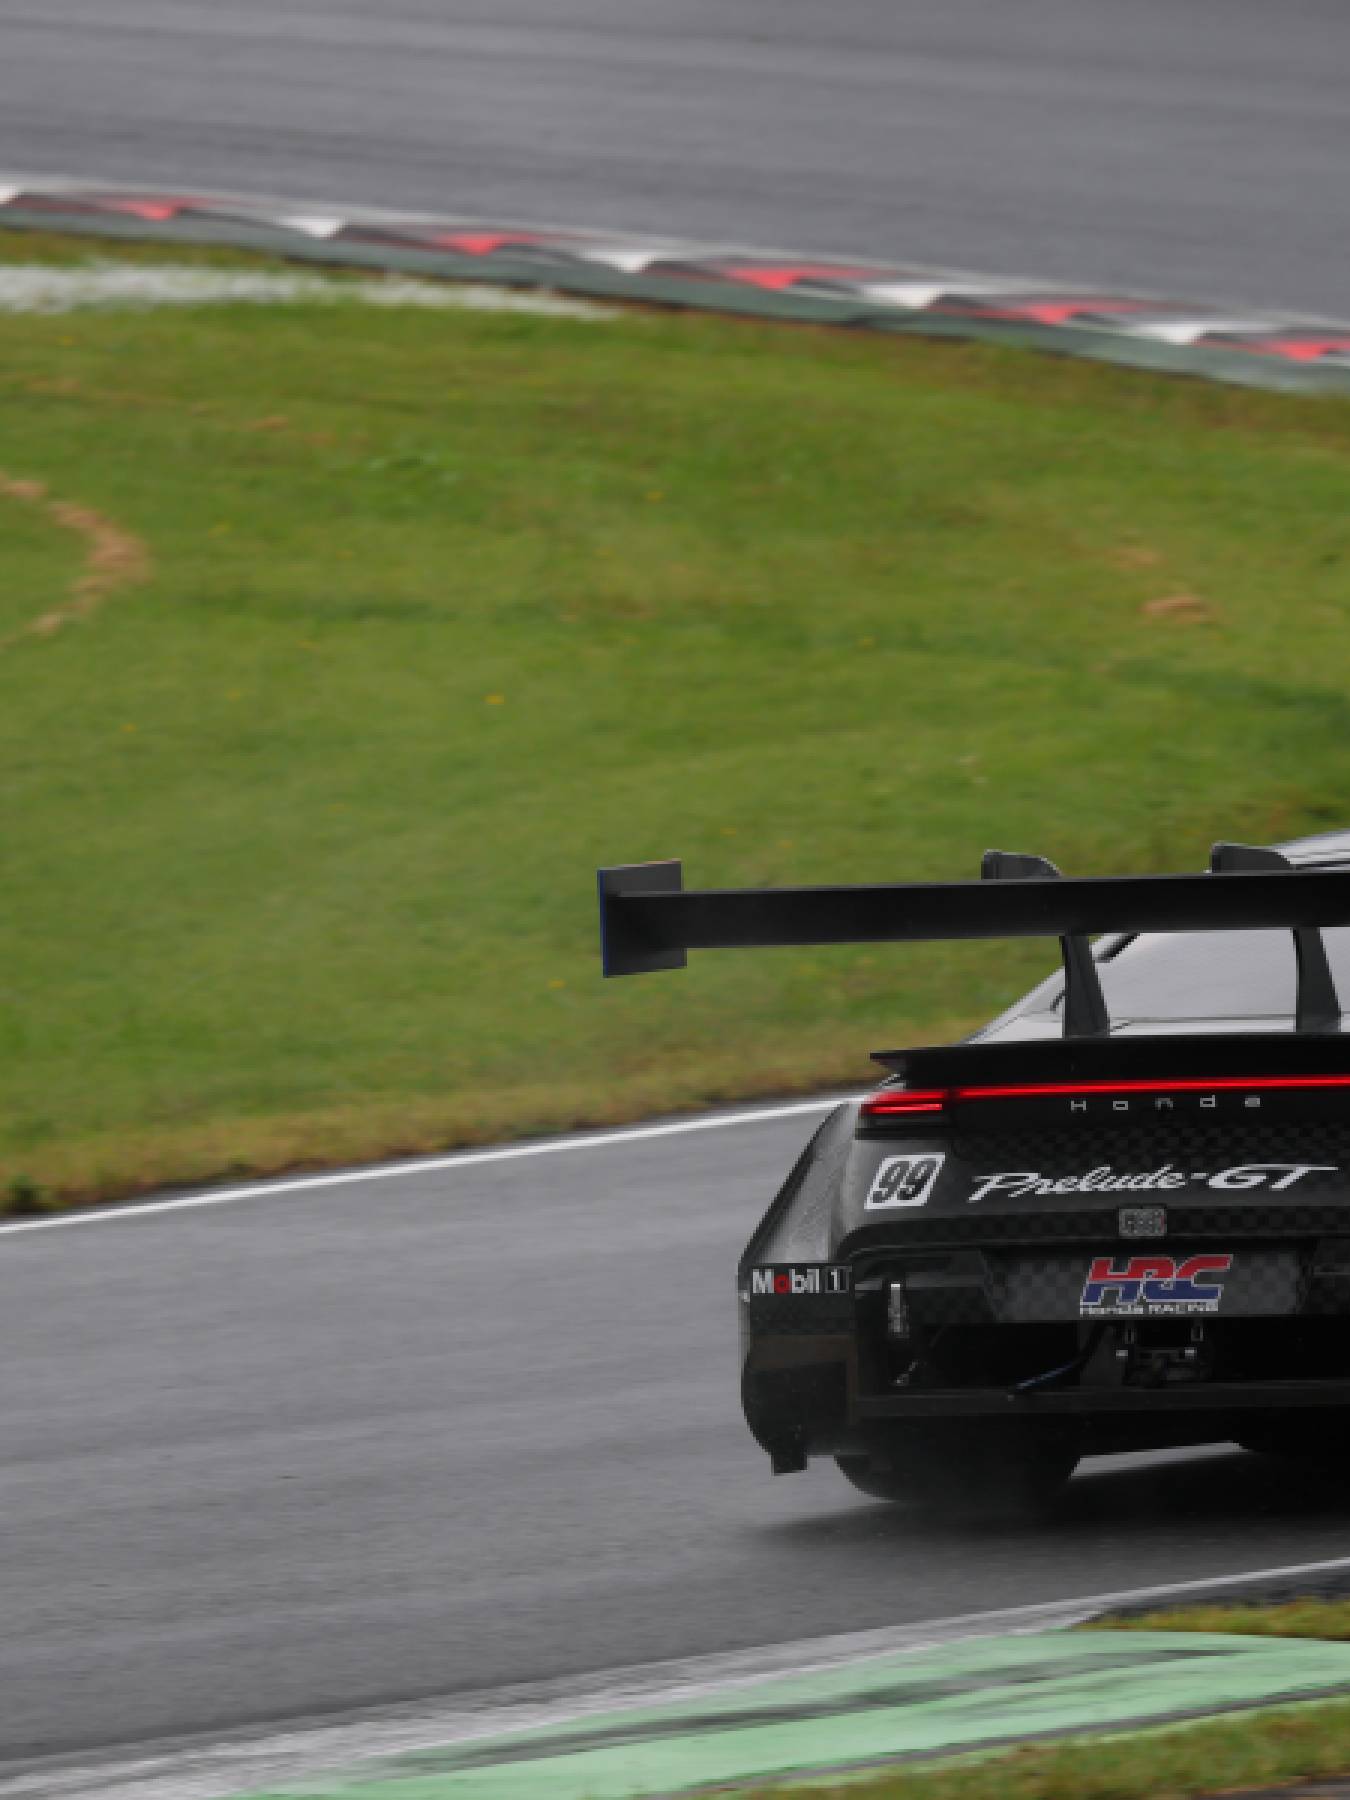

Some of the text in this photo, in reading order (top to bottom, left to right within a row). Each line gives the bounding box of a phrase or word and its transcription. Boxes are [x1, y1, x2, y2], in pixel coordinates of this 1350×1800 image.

[872, 1159, 937, 1204] 99
[967, 1163, 1339, 1203] Prelude-GT
[752, 1268, 820, 1295] Mobil
[1080, 1254, 1234, 1305] HRC
